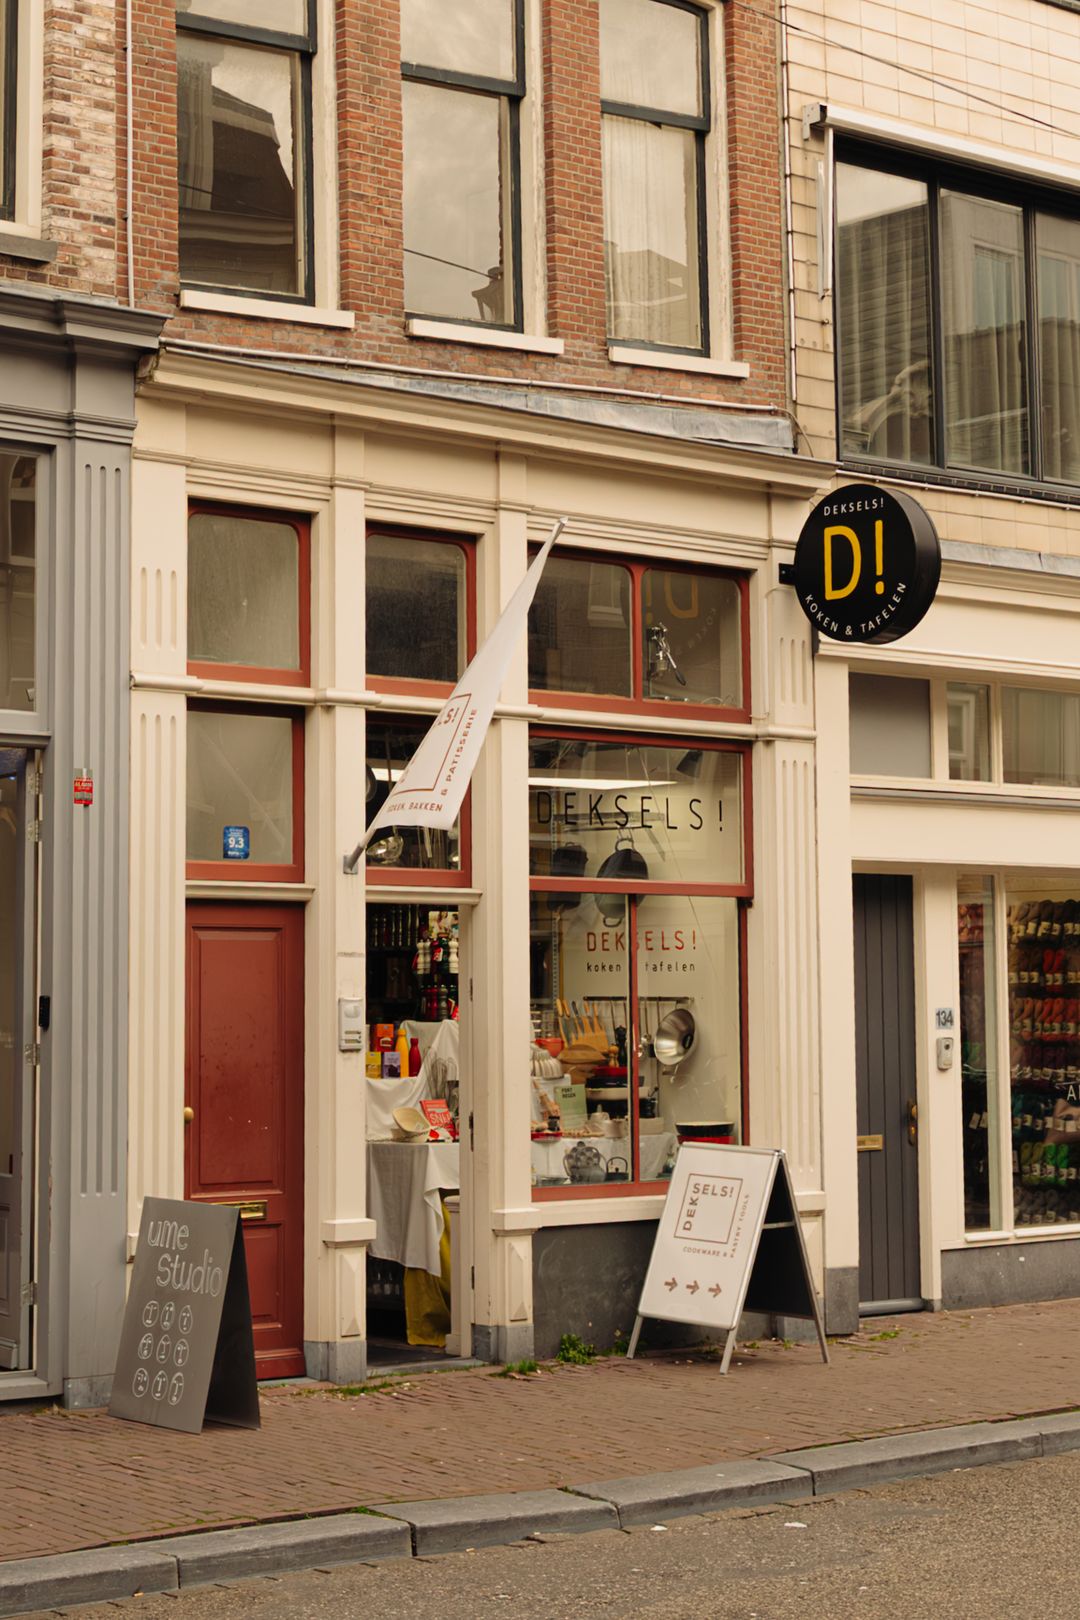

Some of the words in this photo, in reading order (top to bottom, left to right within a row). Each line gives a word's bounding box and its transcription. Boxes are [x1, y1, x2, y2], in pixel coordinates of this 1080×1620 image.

[823, 497, 884, 517] DEKSELS!
[823, 519, 886, 601] D!
[804, 593, 839, 633] KOKEN
[844, 624, 854, 636] &
[860, 582, 907, 634] TAFELEN
[445, 708, 478, 782] PATISSERIE
[536, 791, 724, 832] DEKSELS!
[229, 836, 244, 848] 9.3
[586, 930, 697, 952] DEKELS!
[586, 961, 622, 973] koken
[644, 961, 696, 973] tafelen
[935, 1009, 954, 1027] 134
[692, 1183, 735, 1198] SELS!
[683, 1196, 700, 1230] DEK
[147, 1220, 190, 1250] ume
[683, 1246, 720, 1257] COOKWARE
